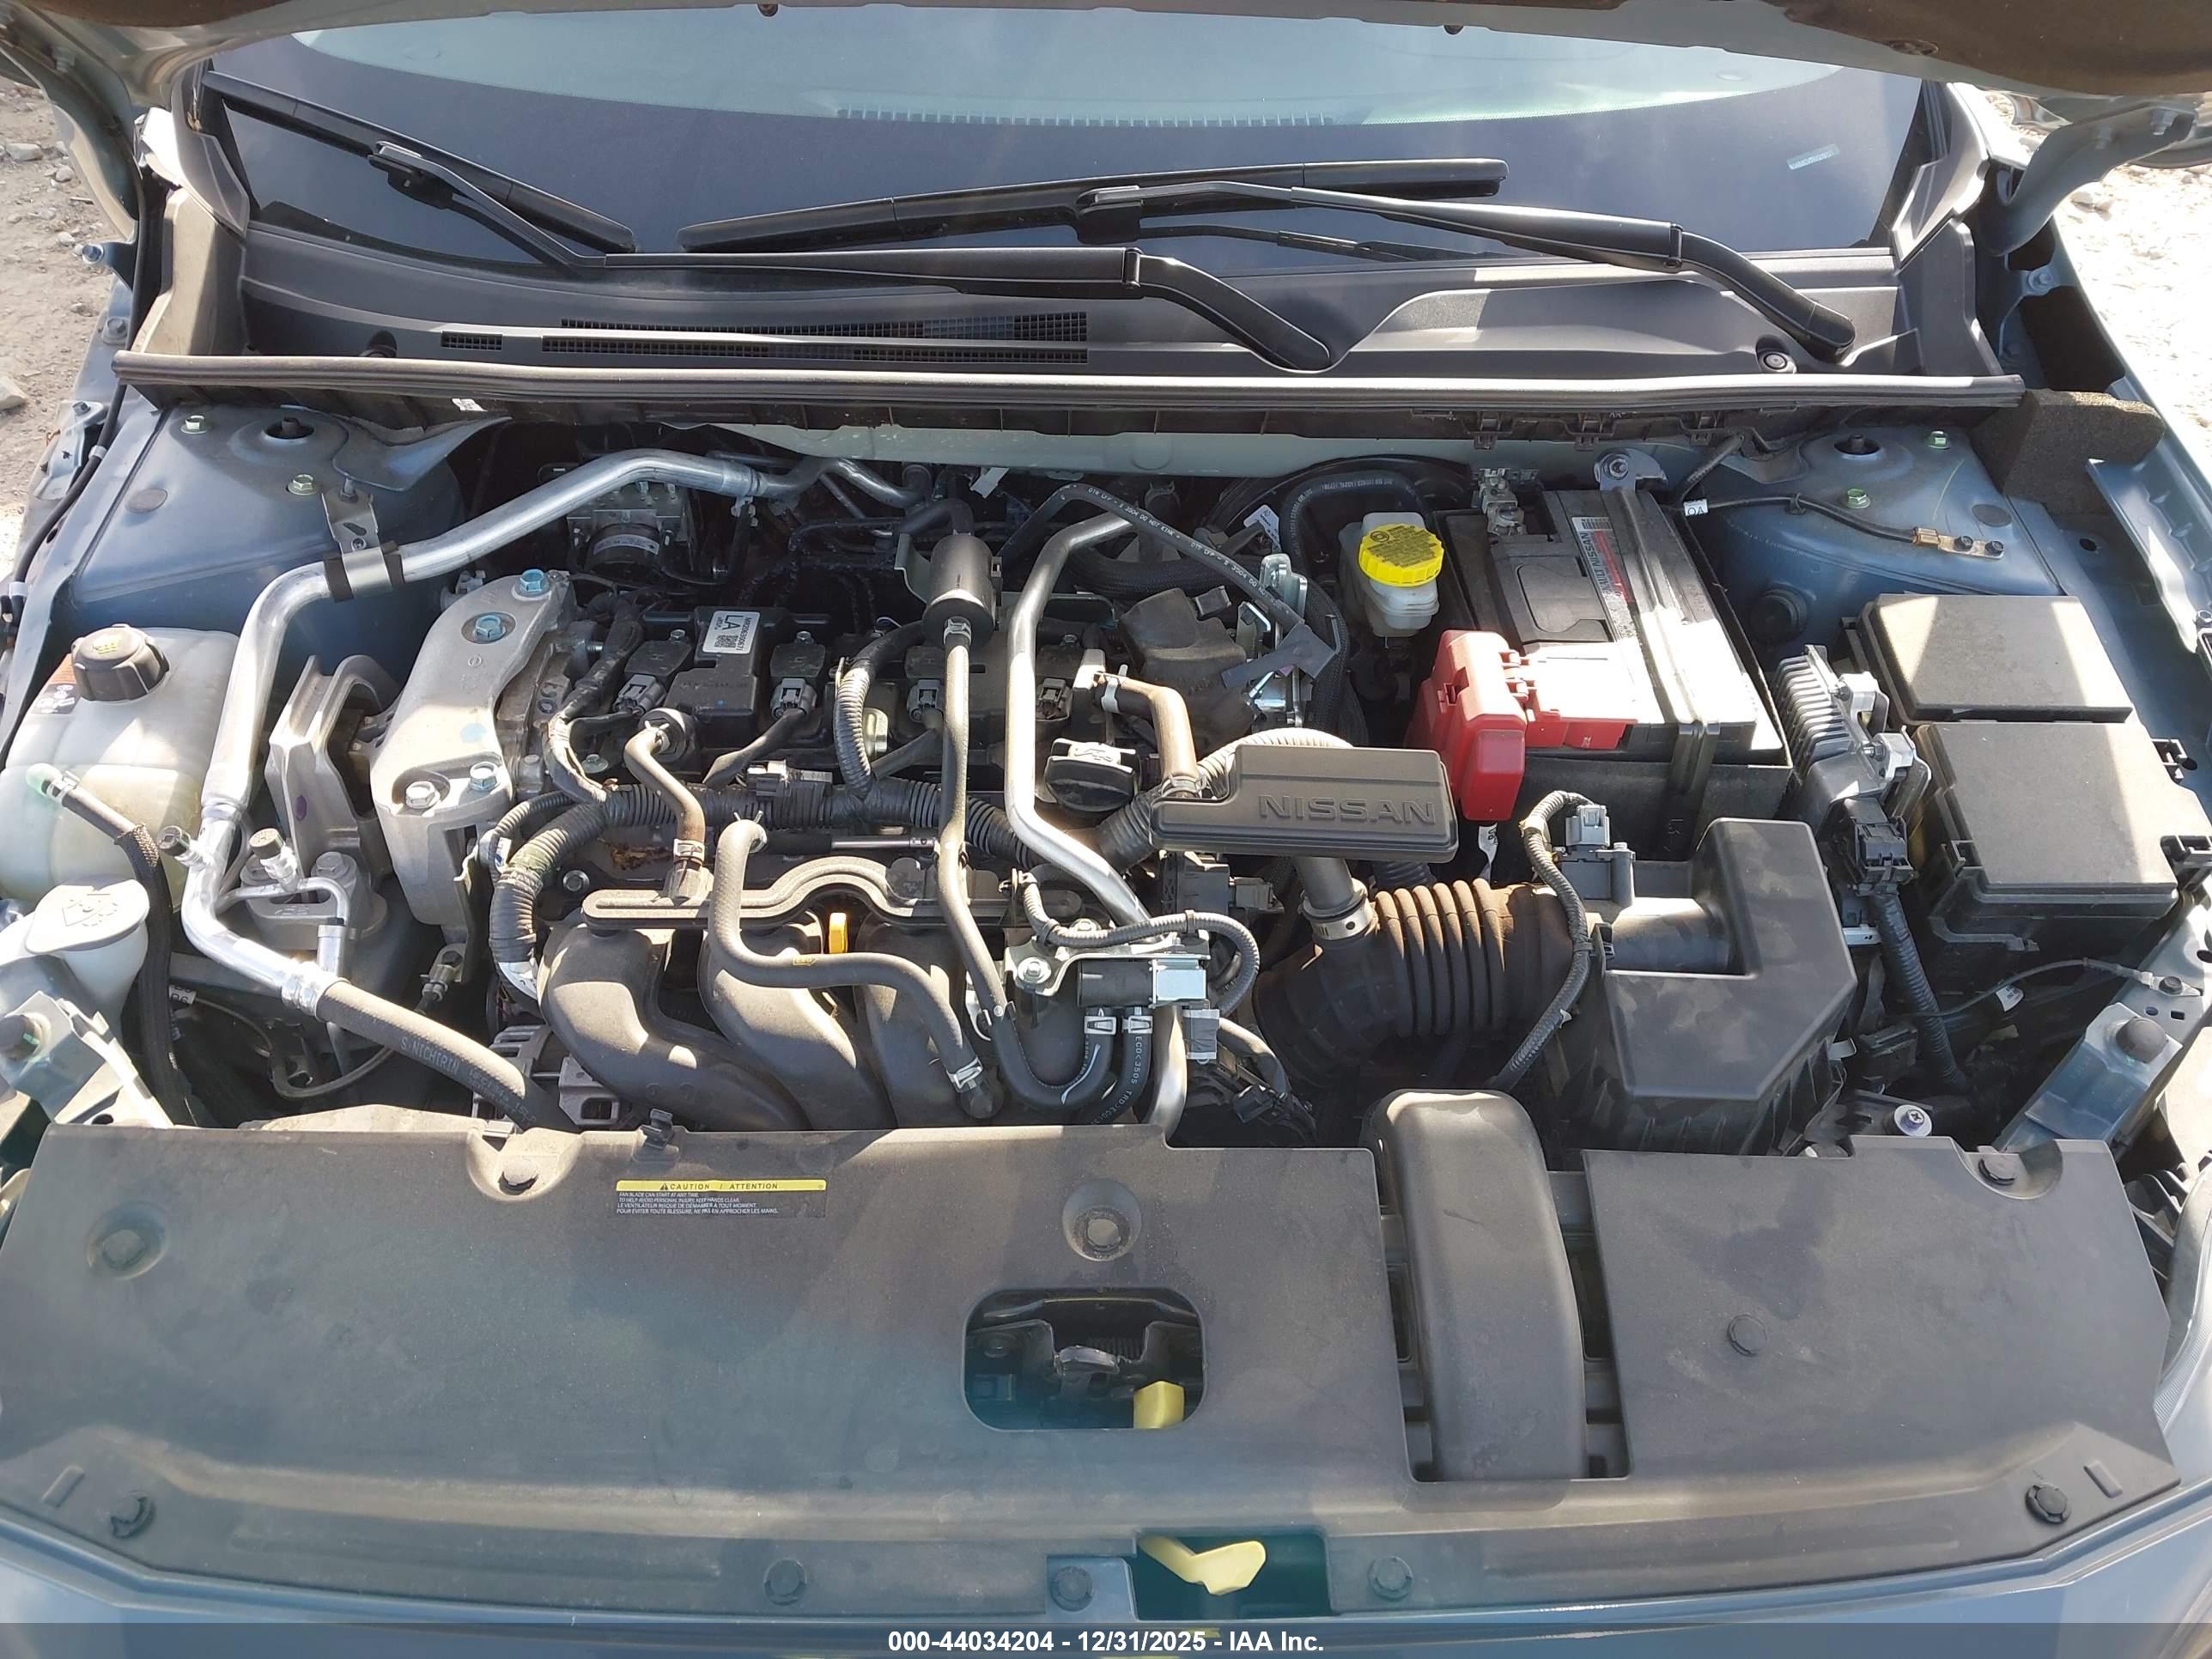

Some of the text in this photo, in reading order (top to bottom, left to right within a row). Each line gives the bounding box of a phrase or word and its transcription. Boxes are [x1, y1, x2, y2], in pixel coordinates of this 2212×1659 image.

[1579, 532, 1602, 568] NISSAN
[721, 615, 744, 631] LA
[1258, 794, 1437, 824] NISSAN
